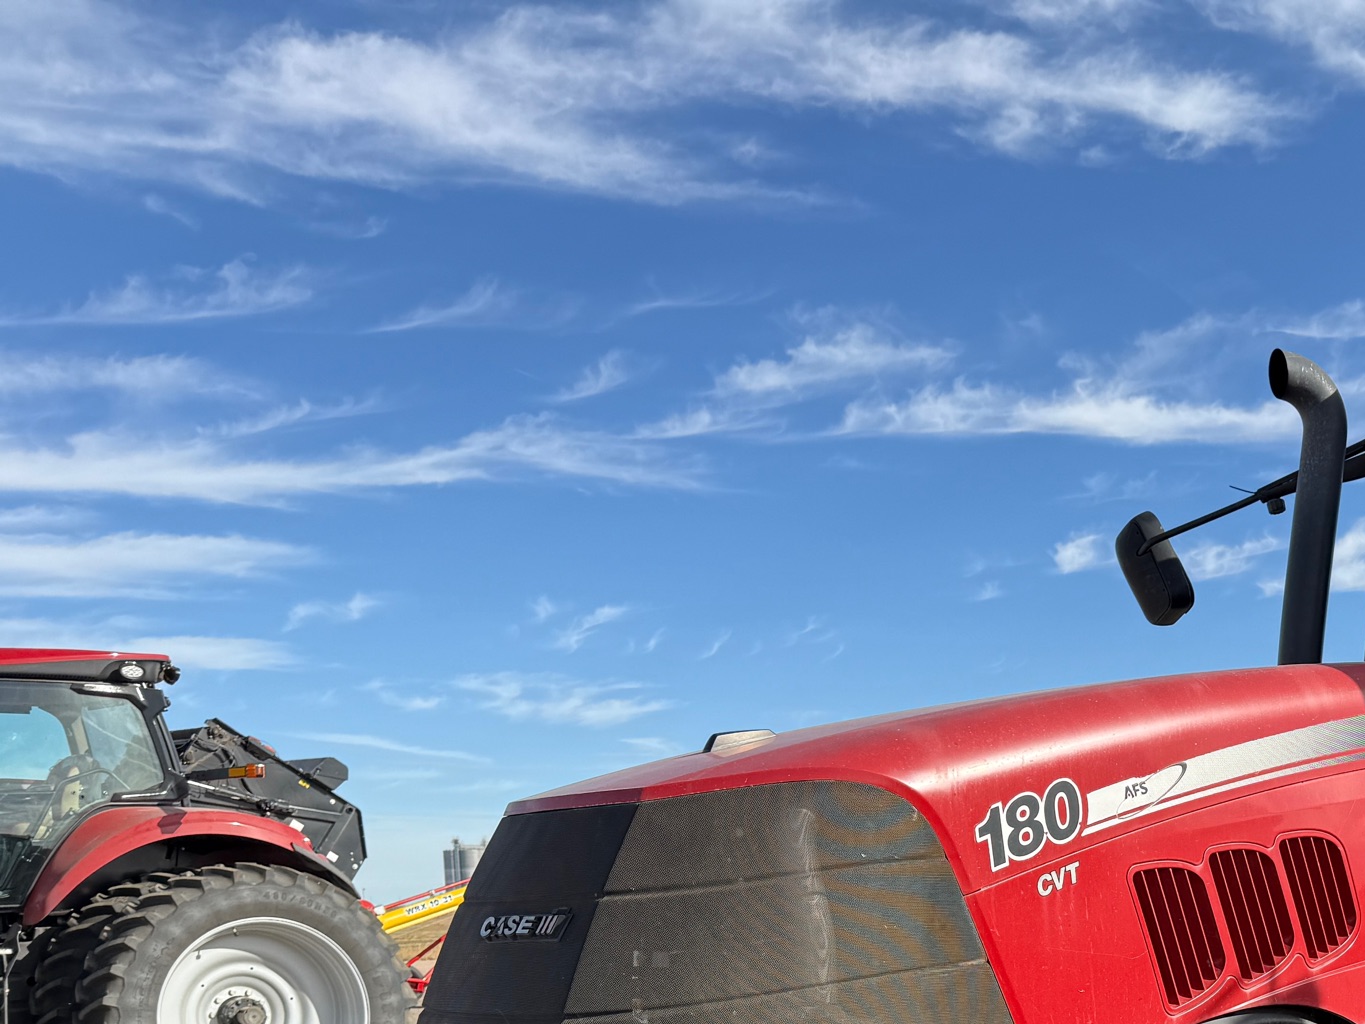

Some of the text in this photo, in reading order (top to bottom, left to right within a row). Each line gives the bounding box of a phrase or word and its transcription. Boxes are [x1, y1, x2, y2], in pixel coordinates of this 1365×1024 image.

[1124, 781, 1148, 799] AFS
[975, 777, 1082, 873] 180
[1037, 861, 1080, 897] CVT
[480, 915, 536, 937] CASE
